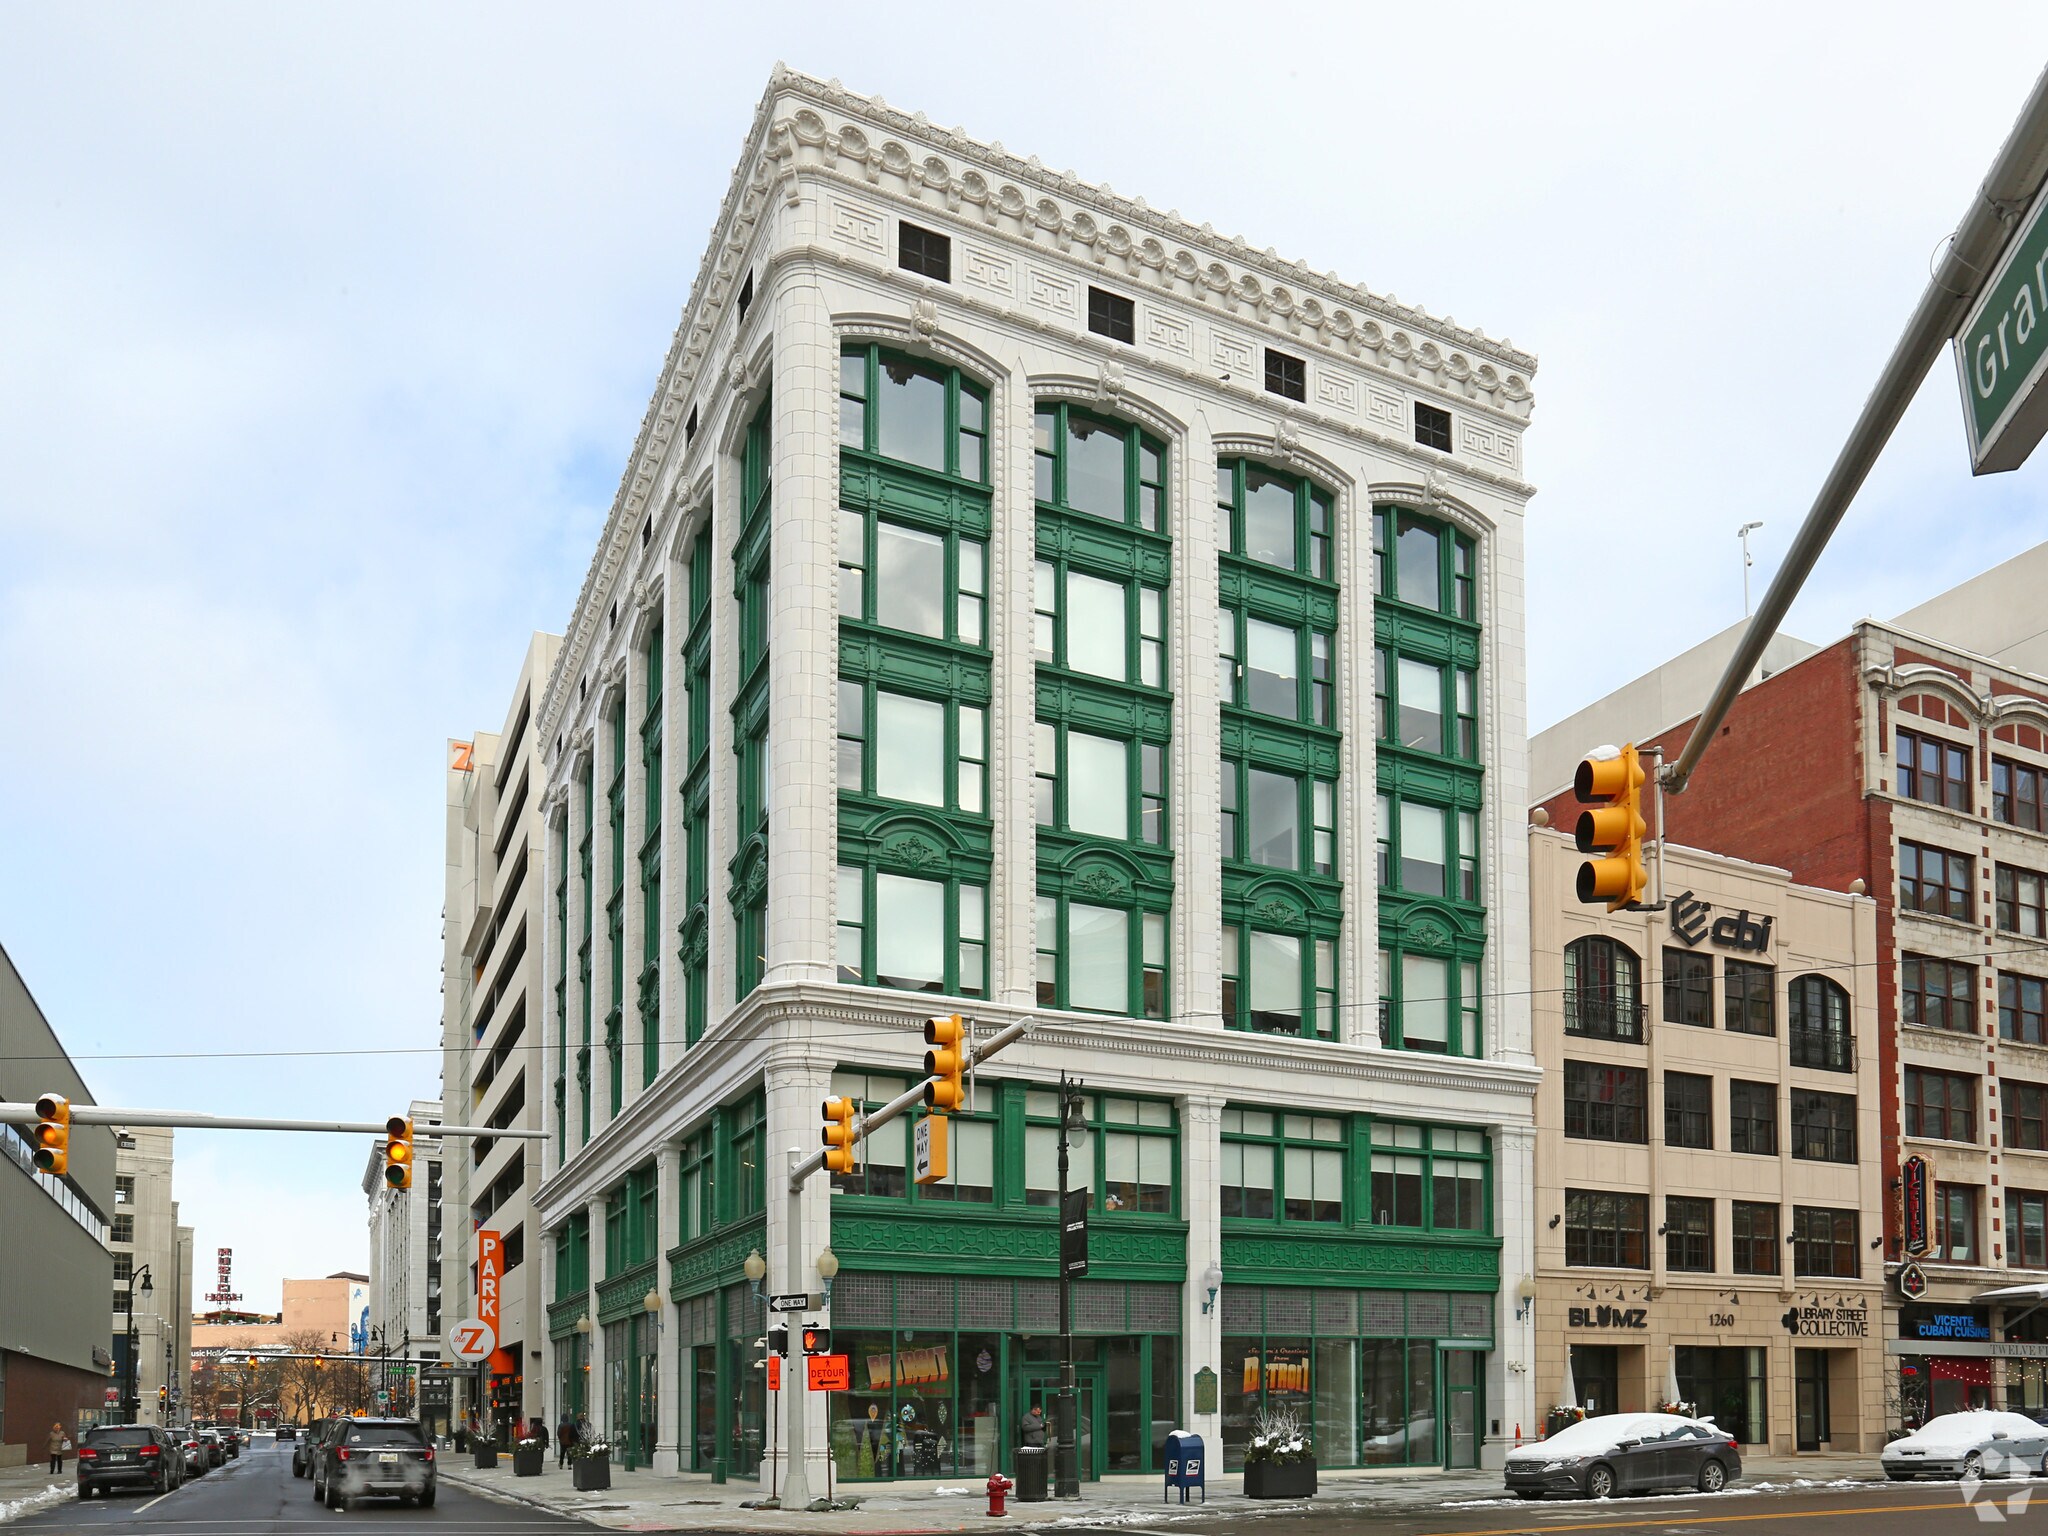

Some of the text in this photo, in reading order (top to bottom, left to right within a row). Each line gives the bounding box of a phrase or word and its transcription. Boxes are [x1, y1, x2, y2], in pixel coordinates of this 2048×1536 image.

[1711, 909, 1773, 952] cbi
[916, 1124, 928, 1141] ONE
[916, 1139, 929, 1157] WAY
[481, 1238, 497, 1317] PARK
[780, 1298, 805, 1307] ONE WAY
[1708, 1313, 1735, 1327] 1260
[1799, 1307, 1868, 1321] LIBRARY STREET
[1933, 1315, 1974, 1327] VICENTE
[1800, 1320, 1868, 1337] COLLECTIVE
[1919, 1325, 1990, 1338] CUBAN CUISINE
[460, 1328, 485, 1354] Z
[1990, 1344, 2037, 1356] TWELVE
[811, 1369, 845, 1378] DETOUR
